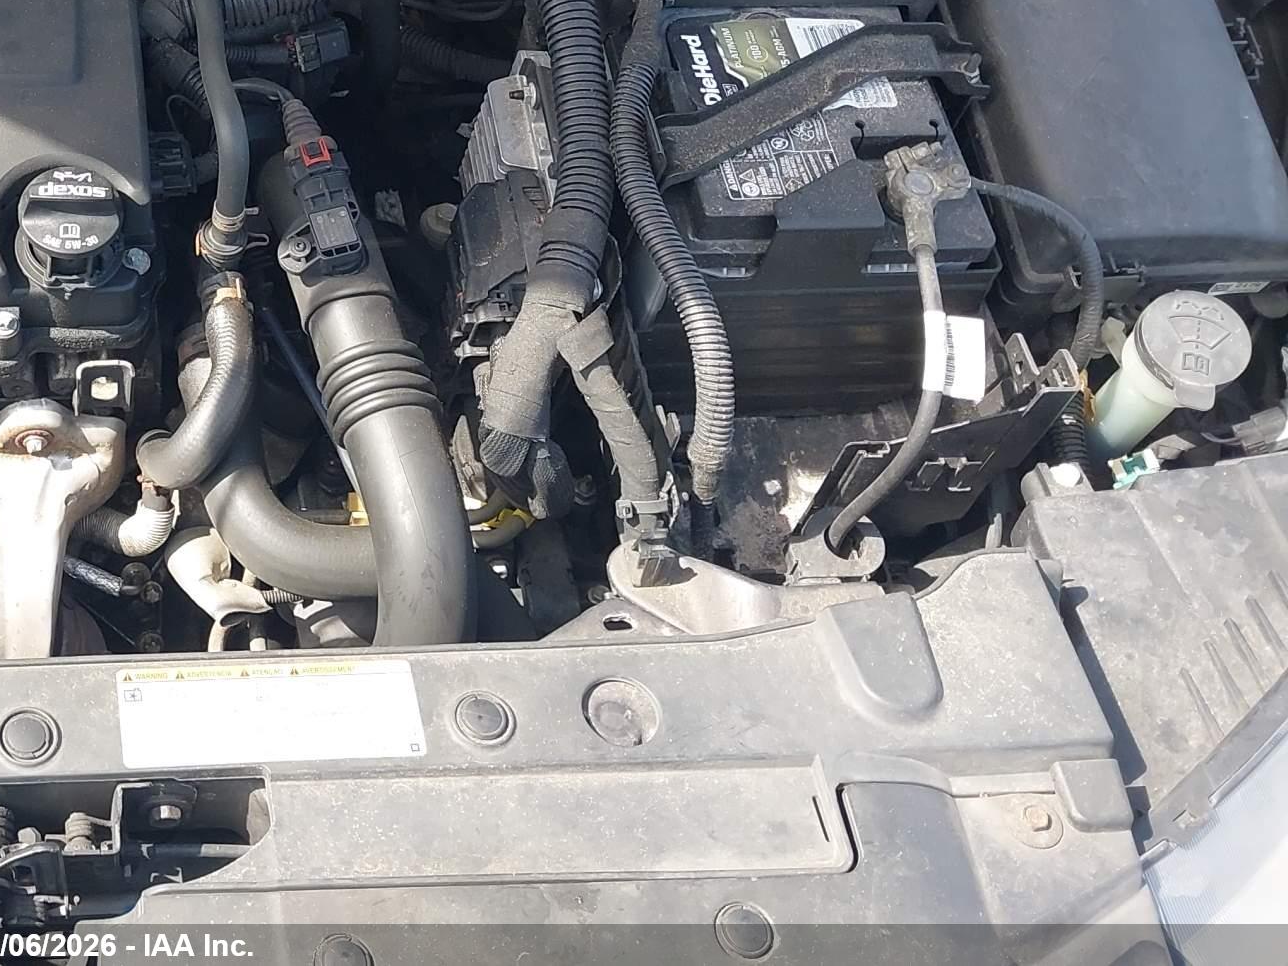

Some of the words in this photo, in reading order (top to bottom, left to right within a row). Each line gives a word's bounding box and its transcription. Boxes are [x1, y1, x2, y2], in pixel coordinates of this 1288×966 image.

[720, 27, 745, 68] PLATINUM
[750, 45, 763, 60] 100
[680, 34, 723, 106] DieHard
[38, 181, 107, 198] dexos
[42, 234, 63, 249] SAE
[64, 234, 99, 250] 5W-30
[134, 672, 169, 680] WARNING
